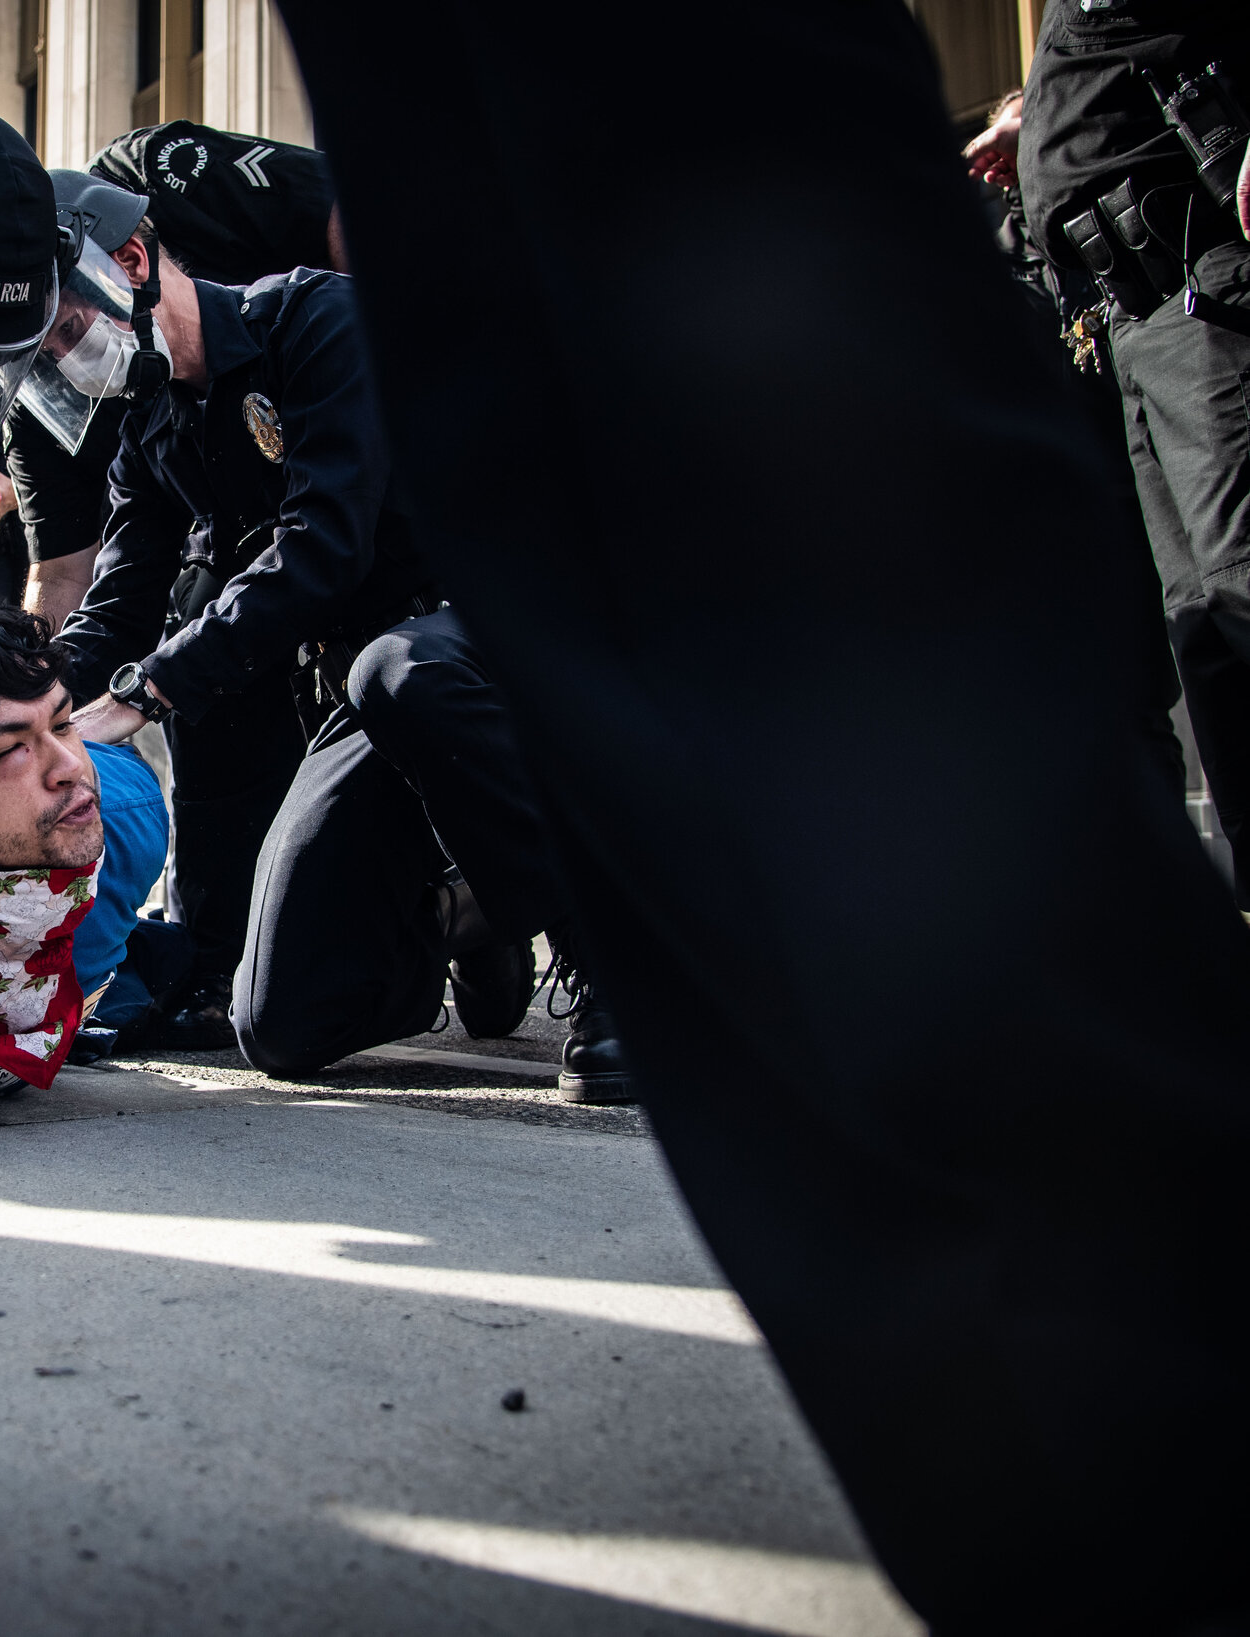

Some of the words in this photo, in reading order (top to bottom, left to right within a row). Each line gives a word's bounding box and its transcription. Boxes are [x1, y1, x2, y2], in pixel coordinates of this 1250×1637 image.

[157, 137, 195, 171] ANGELES
[190, 144, 208, 178] POLICE
[163, 172, 187, 194] LOS
